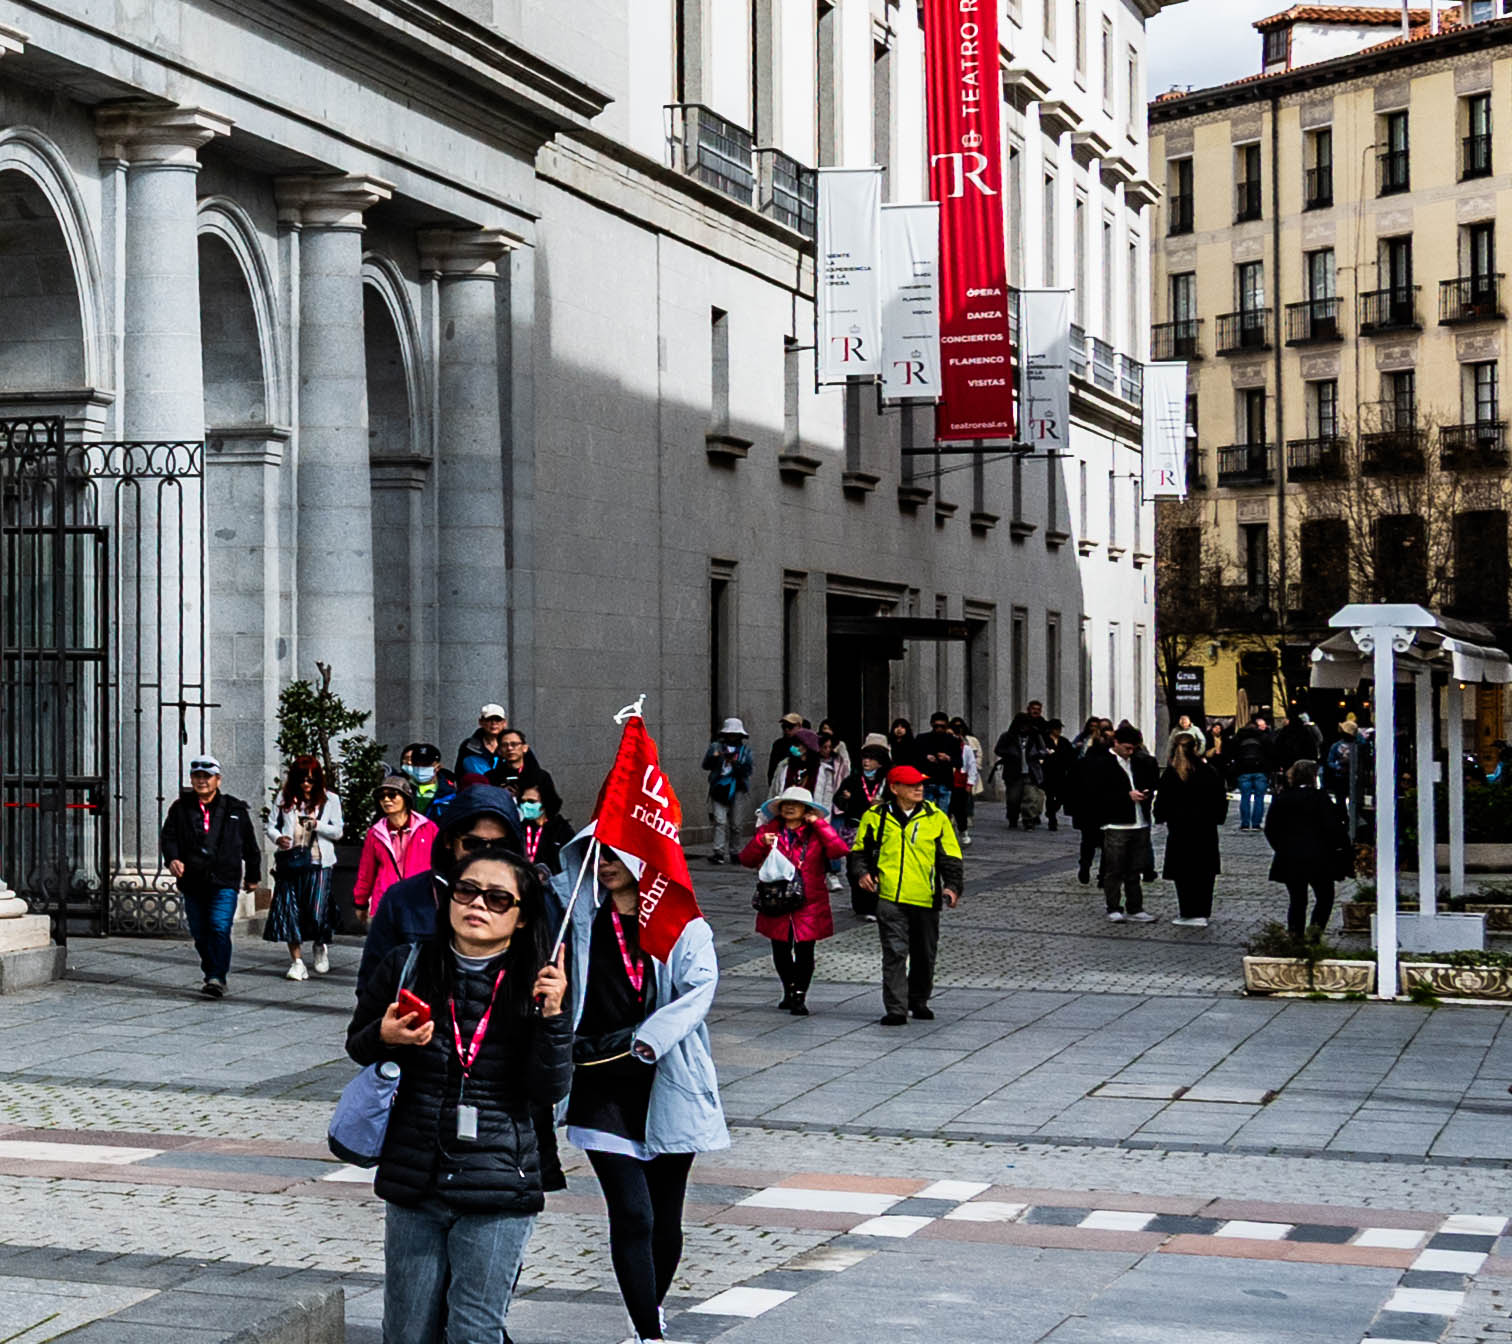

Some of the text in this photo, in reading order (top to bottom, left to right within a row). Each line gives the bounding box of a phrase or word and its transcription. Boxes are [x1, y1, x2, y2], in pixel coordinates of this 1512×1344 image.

[960, 22, 980, 118] TEATRO
[931, 151, 998, 198] TR
[966, 287, 1001, 298] ÓPERA
[967, 310, 1003, 321] DANZA
[941, 332, 1004, 344] CONCIERTOS
[831, 336, 868, 363] TR
[949, 355, 1005, 366] FLAMENCO
[893, 360, 929, 385] TR
[967, 378, 1006, 387] VISITAS
[950, 420, 1008, 430] teatroreal.es
